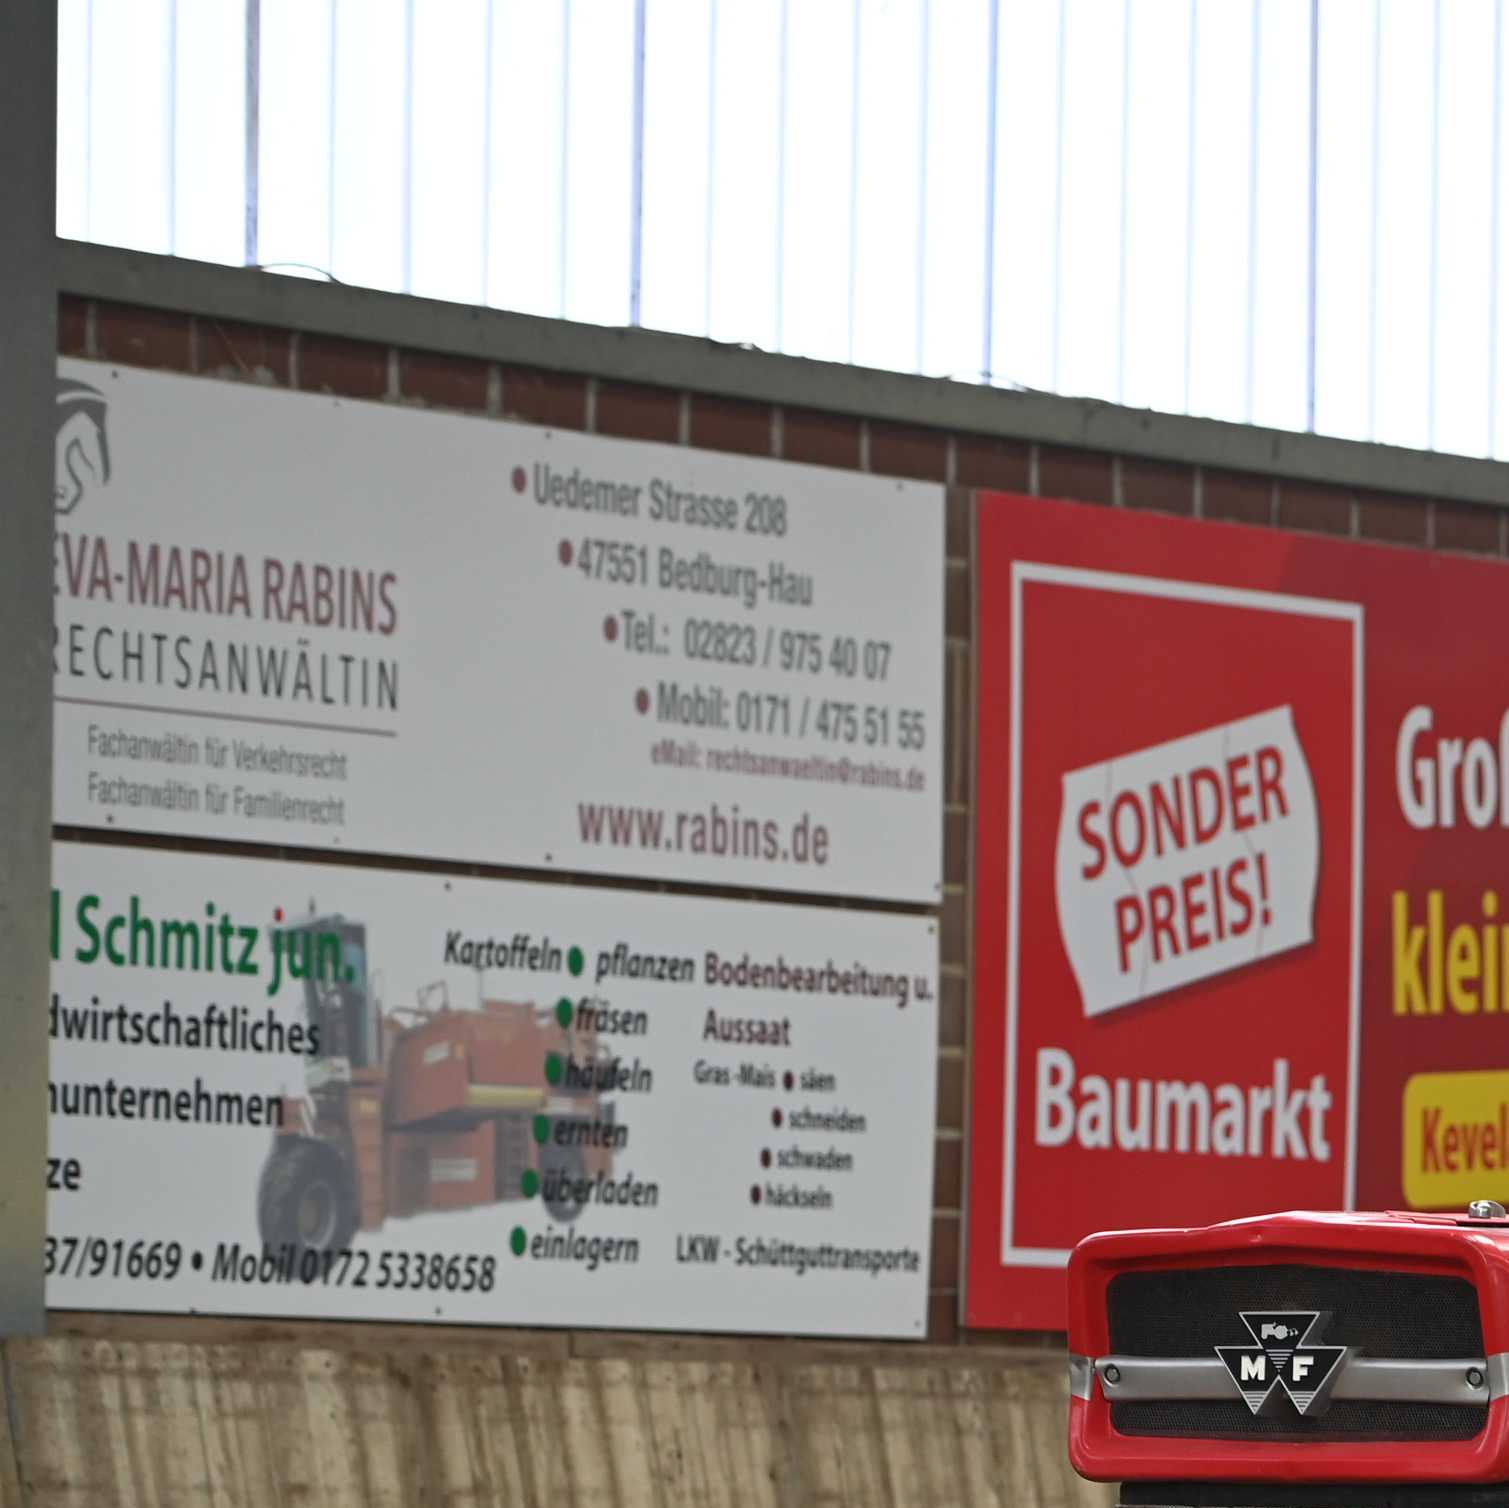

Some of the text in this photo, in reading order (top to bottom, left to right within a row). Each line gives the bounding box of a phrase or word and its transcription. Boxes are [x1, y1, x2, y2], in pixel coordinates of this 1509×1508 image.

[533, 462, 788, 537] Uedemer Strasse 208
[52, 531, 397, 636] VA-MARIA RABINS
[577, 537, 813, 609] 47551 Bedburg-Hau
[684, 617, 756, 667] 02823
[762, 627, 773, 667] /
[780, 628, 821, 674] 975
[829, 637, 857, 678] 40
[864, 639, 891, 681] 07
[656, 681, 925, 750] Mobil: 0171 / 475 51 55
[88, 723, 347, 781] Fachanwältin für Verkehrsrecht
[88, 770, 345, 825] Fachanwältin für Familienrecht
[1077, 745, 1290, 881] SONDER
[578, 802, 829, 865] www.rabins.de
[1114, 851, 1272, 975] PREIS!
[75, 894, 259, 976] Schmitz
[268, 907, 355, 997] jun.
[444, 930, 695, 984] Kartoffeln pflanzen
[704, 951, 933, 1009] Bodenbearbeitung u.
[576, 999, 648, 1036] fräsen
[703, 1008, 792, 1046] Aussaat
[563, 1057, 653, 1092] häufeln
[693, 1059, 730, 1086] Gras
[800, 1068, 836, 1092] säen
[788, 1107, 867, 1133] schneiden
[1035, 1046, 1333, 1162] Baumarkt
[553, 1118, 629, 1148] ernten
[777, 1145, 853, 1171] schwaden
[543, 1170, 658, 1207] überladen
[765, 1181, 832, 1209] häckseln
[212, 1243, 296, 1284] Mobil
[301, 1247, 368, 1288] 0172
[376, 1252, 497, 1293] 5338658
[530, 1226, 639, 1271] einlagern
[676, 1233, 720, 1264] LKW
